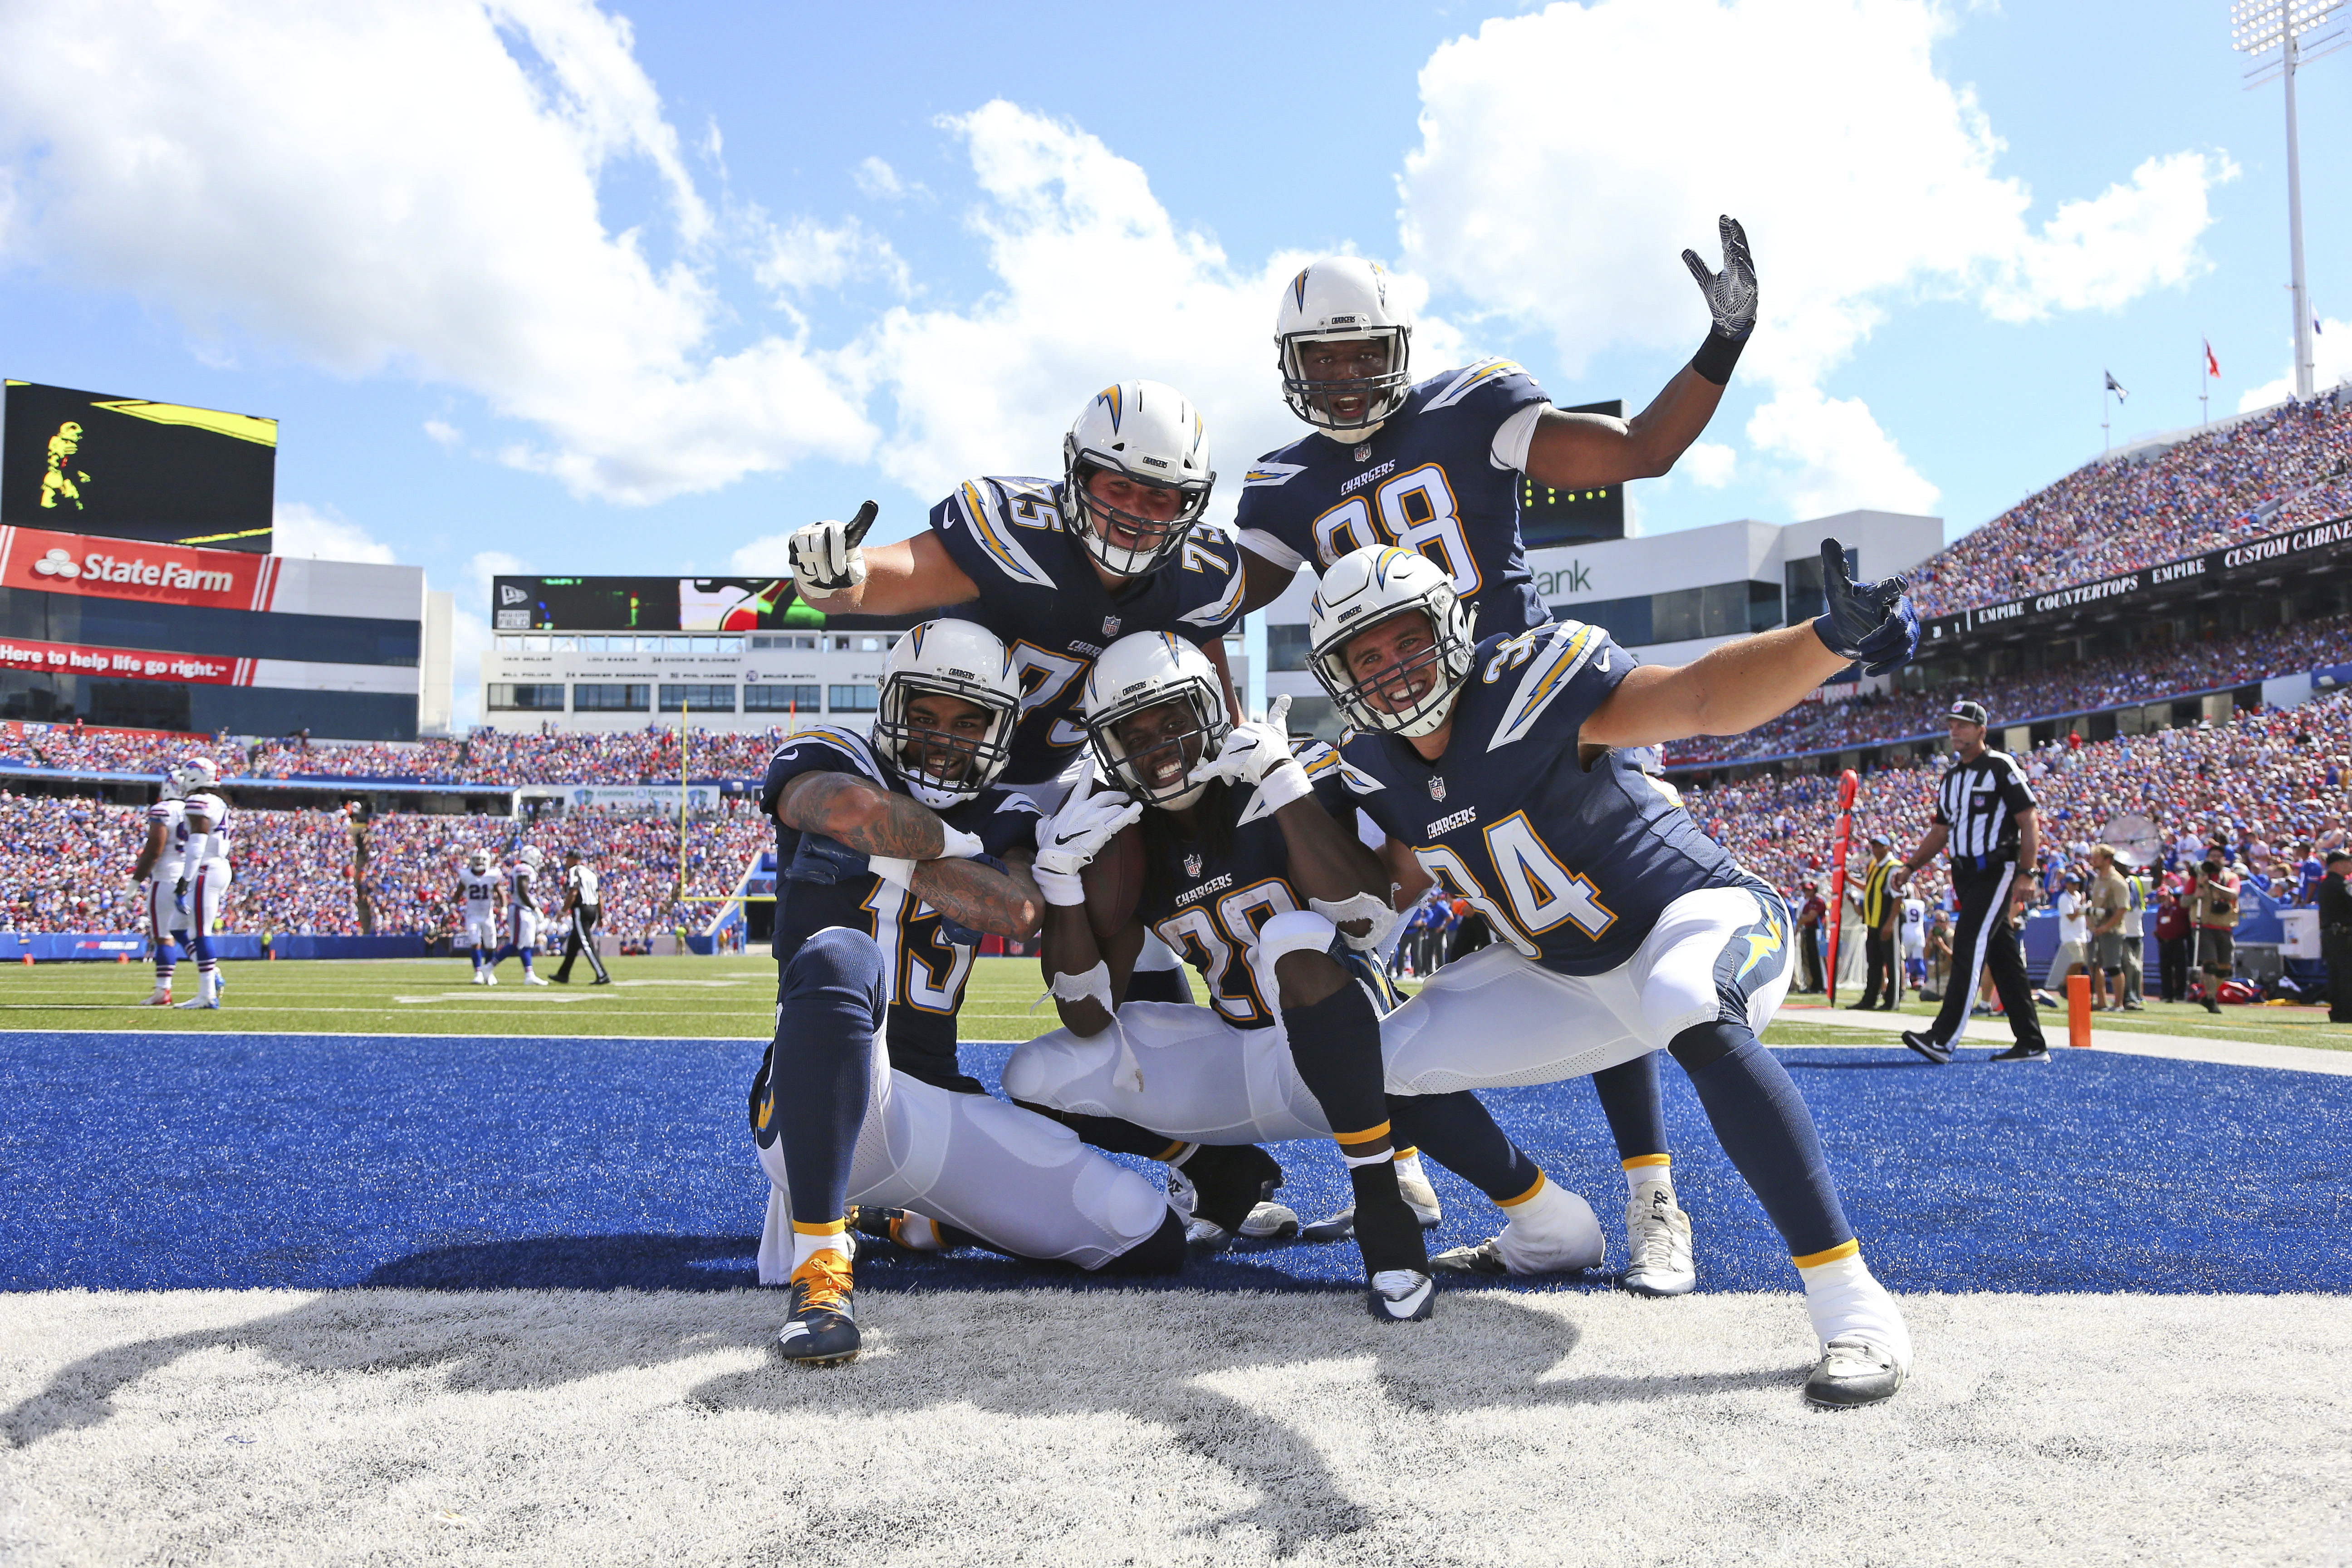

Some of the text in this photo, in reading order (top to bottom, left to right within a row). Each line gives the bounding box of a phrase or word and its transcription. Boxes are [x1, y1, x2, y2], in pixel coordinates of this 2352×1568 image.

[1332, 316, 1356, 324] CHARGERS
[1142, 456, 1168, 468] CHARGERS
[1341, 459, 1396, 496] CHARGERS
[994, 479, 1064, 532] 75
[2224, 536, 2290, 568] CUSTOM
[1529, 559, 1592, 596] ank
[1979, 558, 2205, 623] EMPIRE COUNTERTOPS EMPIRE
[1338, 604, 1362, 624] CHARGERS
[1, 645, 43, 664] Here
[47, 651, 67, 666] to
[70, 652, 109, 671] help
[113, 655, 142, 672] life
[144, 661, 167, 674] go
[1067, 640, 1102, 658] CHAR
[948, 668, 975, 680] CHARGERS
[1122, 681, 1147, 696] CHARGERS
[1432, 787, 1443, 797] NFL
[1427, 806, 1477, 839] CHARGERS
[469, 884, 489, 900] 21
[1175, 872, 1233, 907] CHARGERS
[1411, 809, 1618, 960] 34
[1910, 909, 1918, 922] 9
[859, 877, 975, 1015] 13
